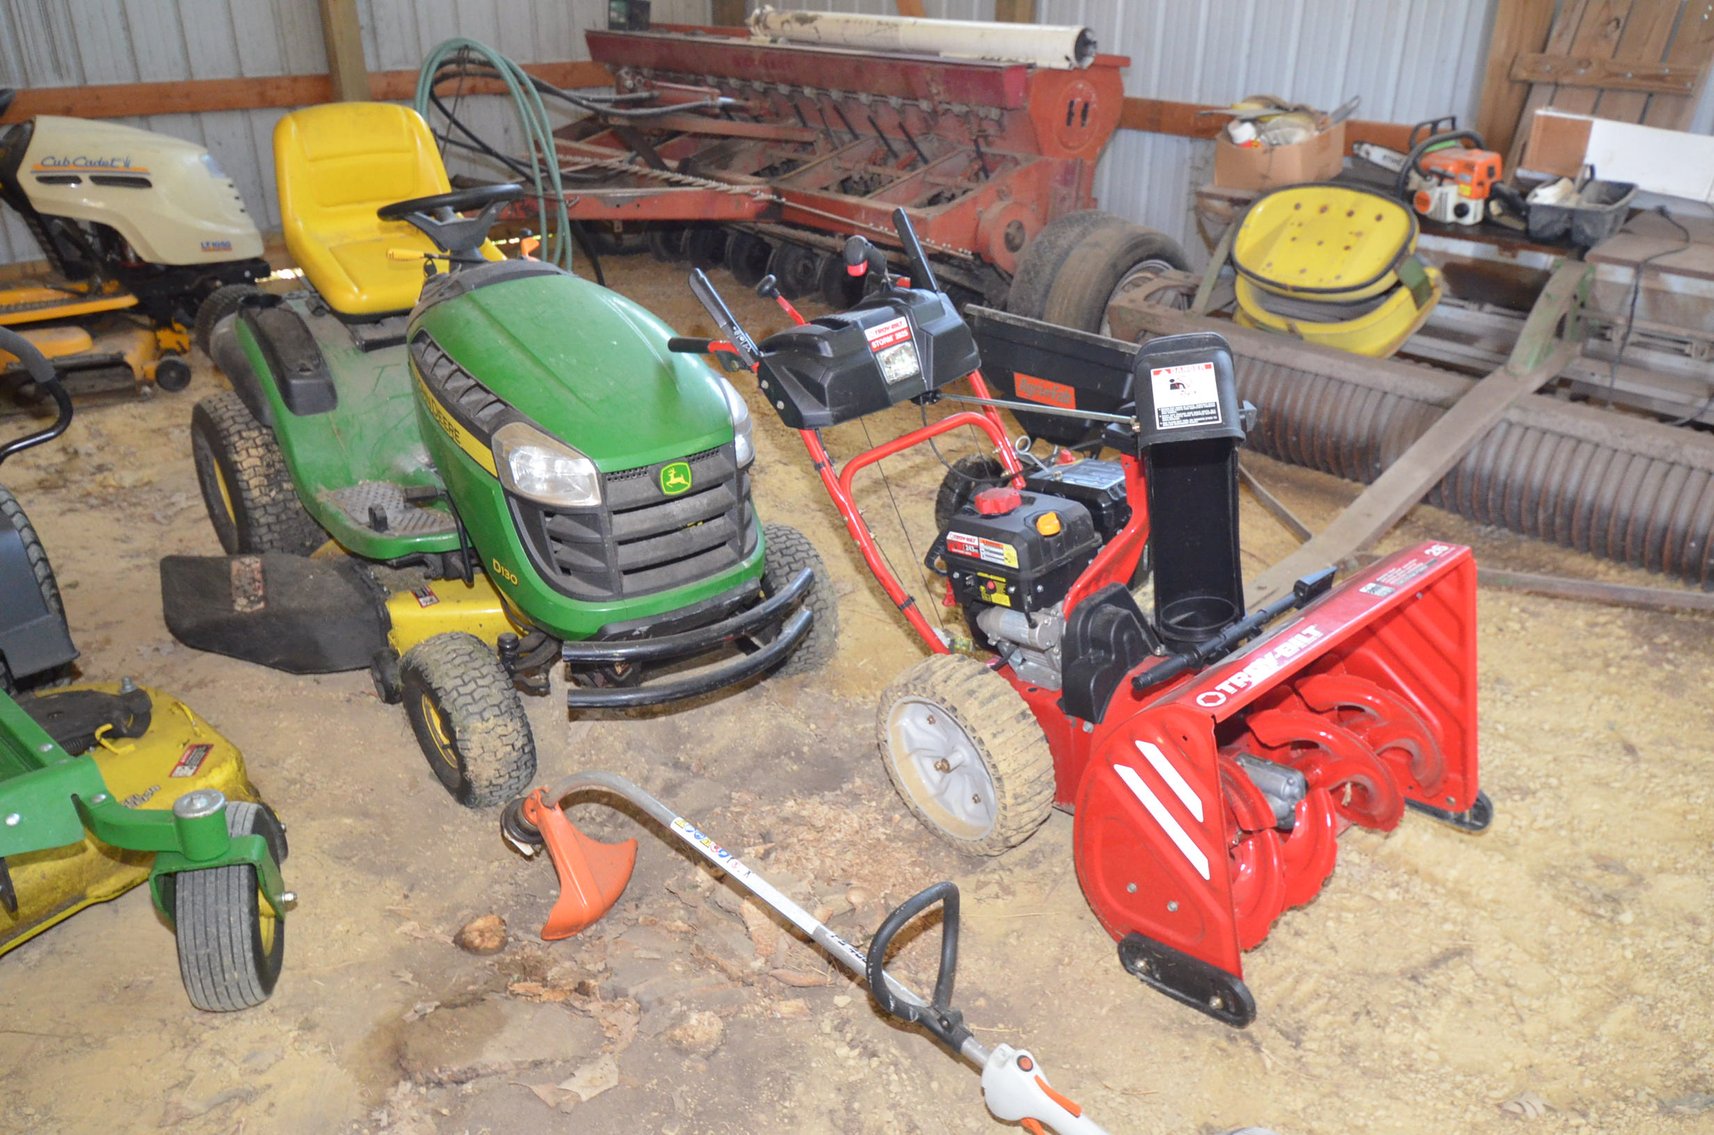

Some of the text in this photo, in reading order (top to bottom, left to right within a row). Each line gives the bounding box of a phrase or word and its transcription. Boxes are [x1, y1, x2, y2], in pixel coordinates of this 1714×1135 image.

[41, 156, 120, 168] Cub Cadet
[874, 321, 903, 335] TROY-BILT
[953, 534, 977, 543] TROY-BILT
[492, 557, 518, 586] D130
[1214, 624, 1324, 695] TROY-BILT
